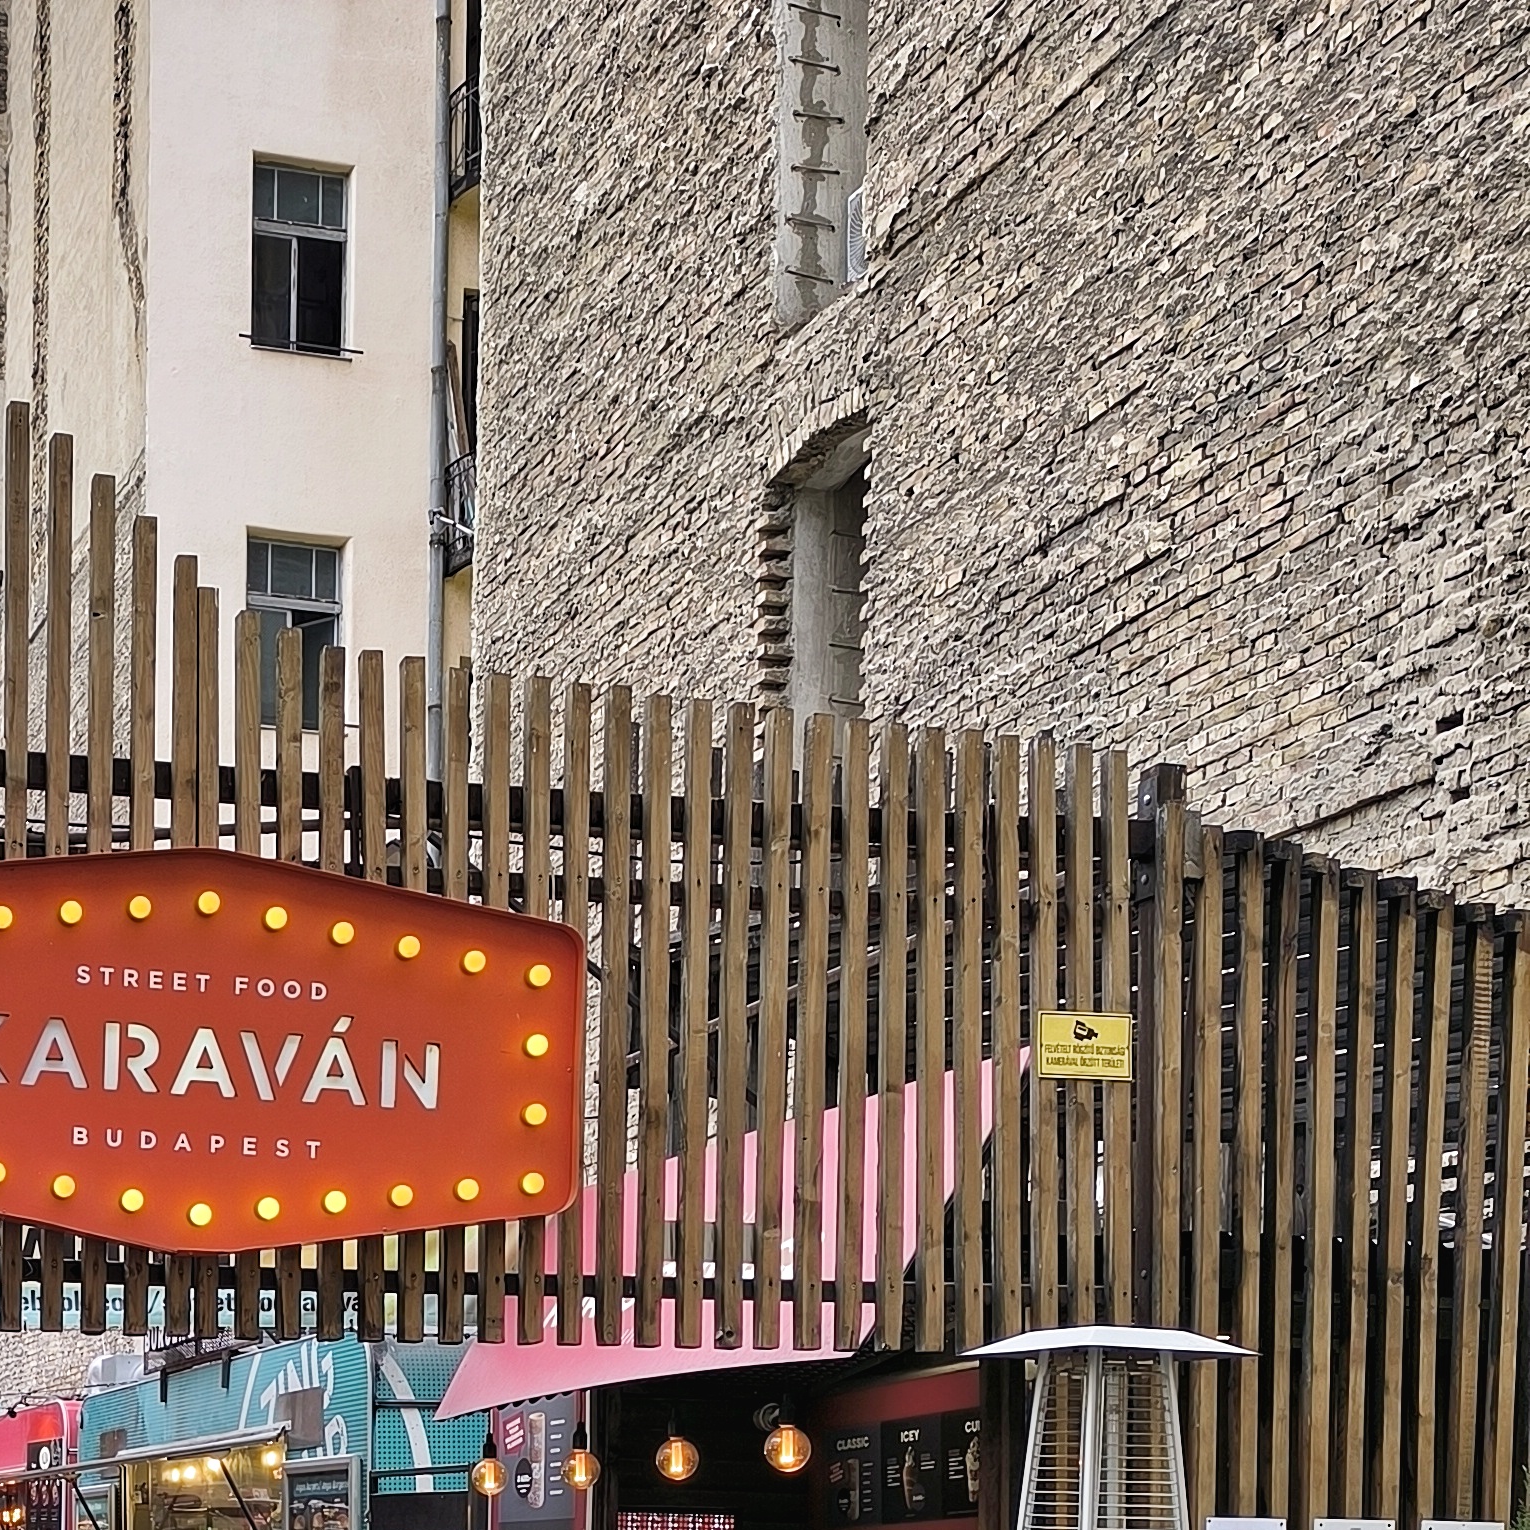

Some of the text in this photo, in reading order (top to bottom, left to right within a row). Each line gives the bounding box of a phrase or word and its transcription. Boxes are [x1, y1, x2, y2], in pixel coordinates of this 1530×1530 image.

[75, 964, 329, 1001] STREET FOOD
[71, 1125, 326, 1160] BUDAPEST
[836, 1436, 870, 1452] CLASSIC
[900, 1429, 920, 1443] ICEY
